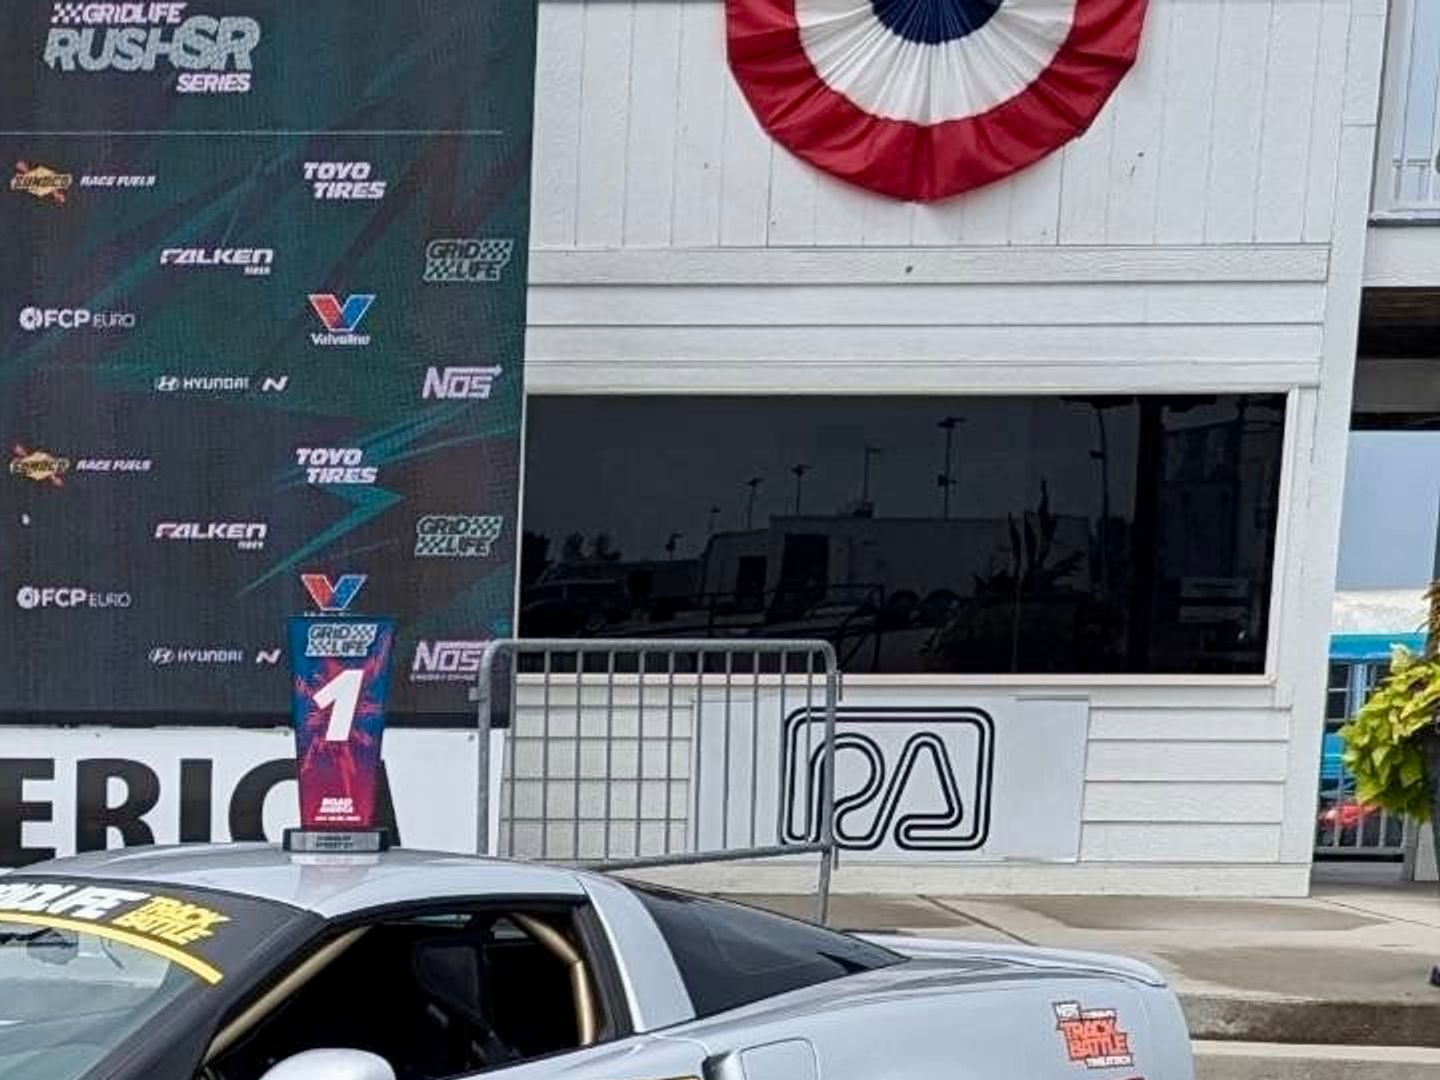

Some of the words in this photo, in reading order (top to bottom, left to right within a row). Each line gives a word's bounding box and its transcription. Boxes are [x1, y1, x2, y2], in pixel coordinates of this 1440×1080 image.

[82, 3, 188, 23] GRIDLIFE
[176, 73, 251, 92] SERIES
[304, 163, 370, 180] TOYO
[314, 181, 386, 200] TIRES
[160, 248, 274, 265] FALKEN
[427, 241, 481, 259] GRID
[450, 261, 497, 279] LIFE
[44, 309, 91, 328] FCP
[93, 313, 136, 328] EURO
[311, 333, 370, 346] Valvoline
[183, 377, 248, 390] HYUNDAI
[422, 366, 494, 399] NOS
[296, 449, 363, 466] TOYO
[306, 467, 377, 484] TIRES
[155, 523, 268, 540] FALKEN
[417, 517, 470, 534] GRID
[444, 535, 491, 555] LIFE
[41, 589, 86, 607] FCP
[88, 593, 131, 607] EURO
[310, 624, 353, 640] GRID
[177, 649, 243, 663] HYUNDAI
[413, 641, 481, 672] NOS
[313, 670, 364, 741] 1
[1070, 1036, 1128, 1058] BATTLE
